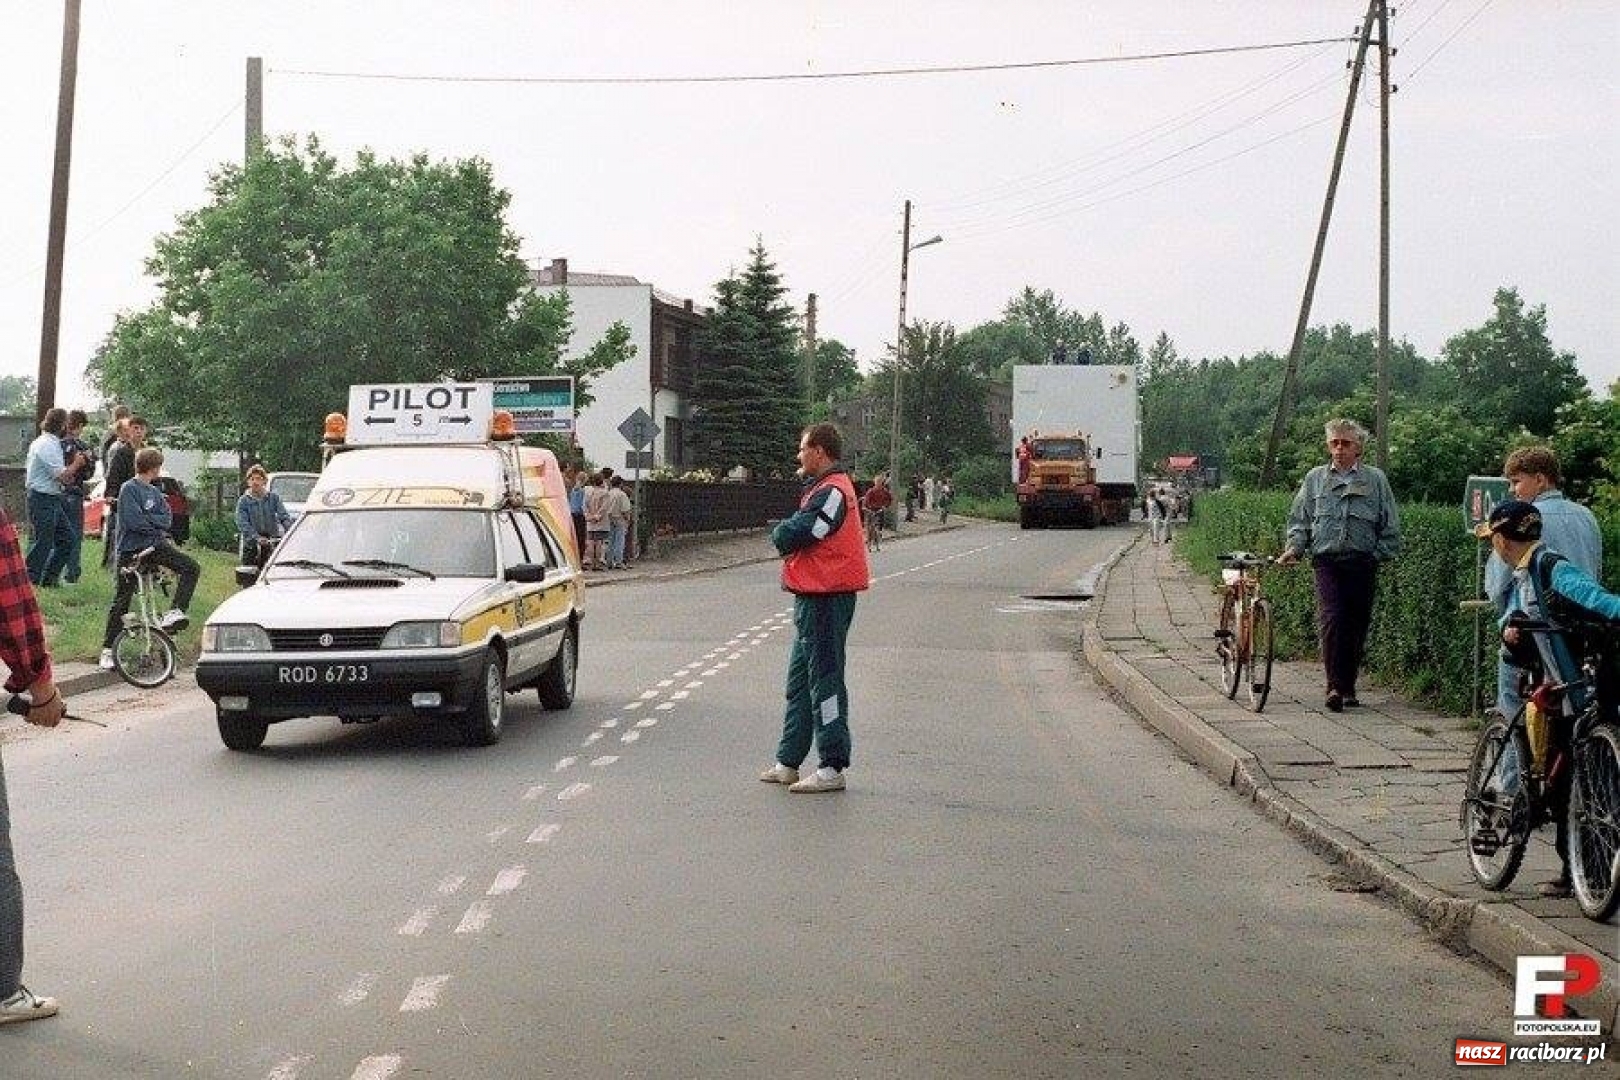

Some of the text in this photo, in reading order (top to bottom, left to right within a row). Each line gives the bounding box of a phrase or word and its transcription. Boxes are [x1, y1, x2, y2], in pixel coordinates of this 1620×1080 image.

[368, 386, 478, 411] PILOT
[414, 414, 422, 427] 5
[279, 665, 369, 683] ROD 6733
